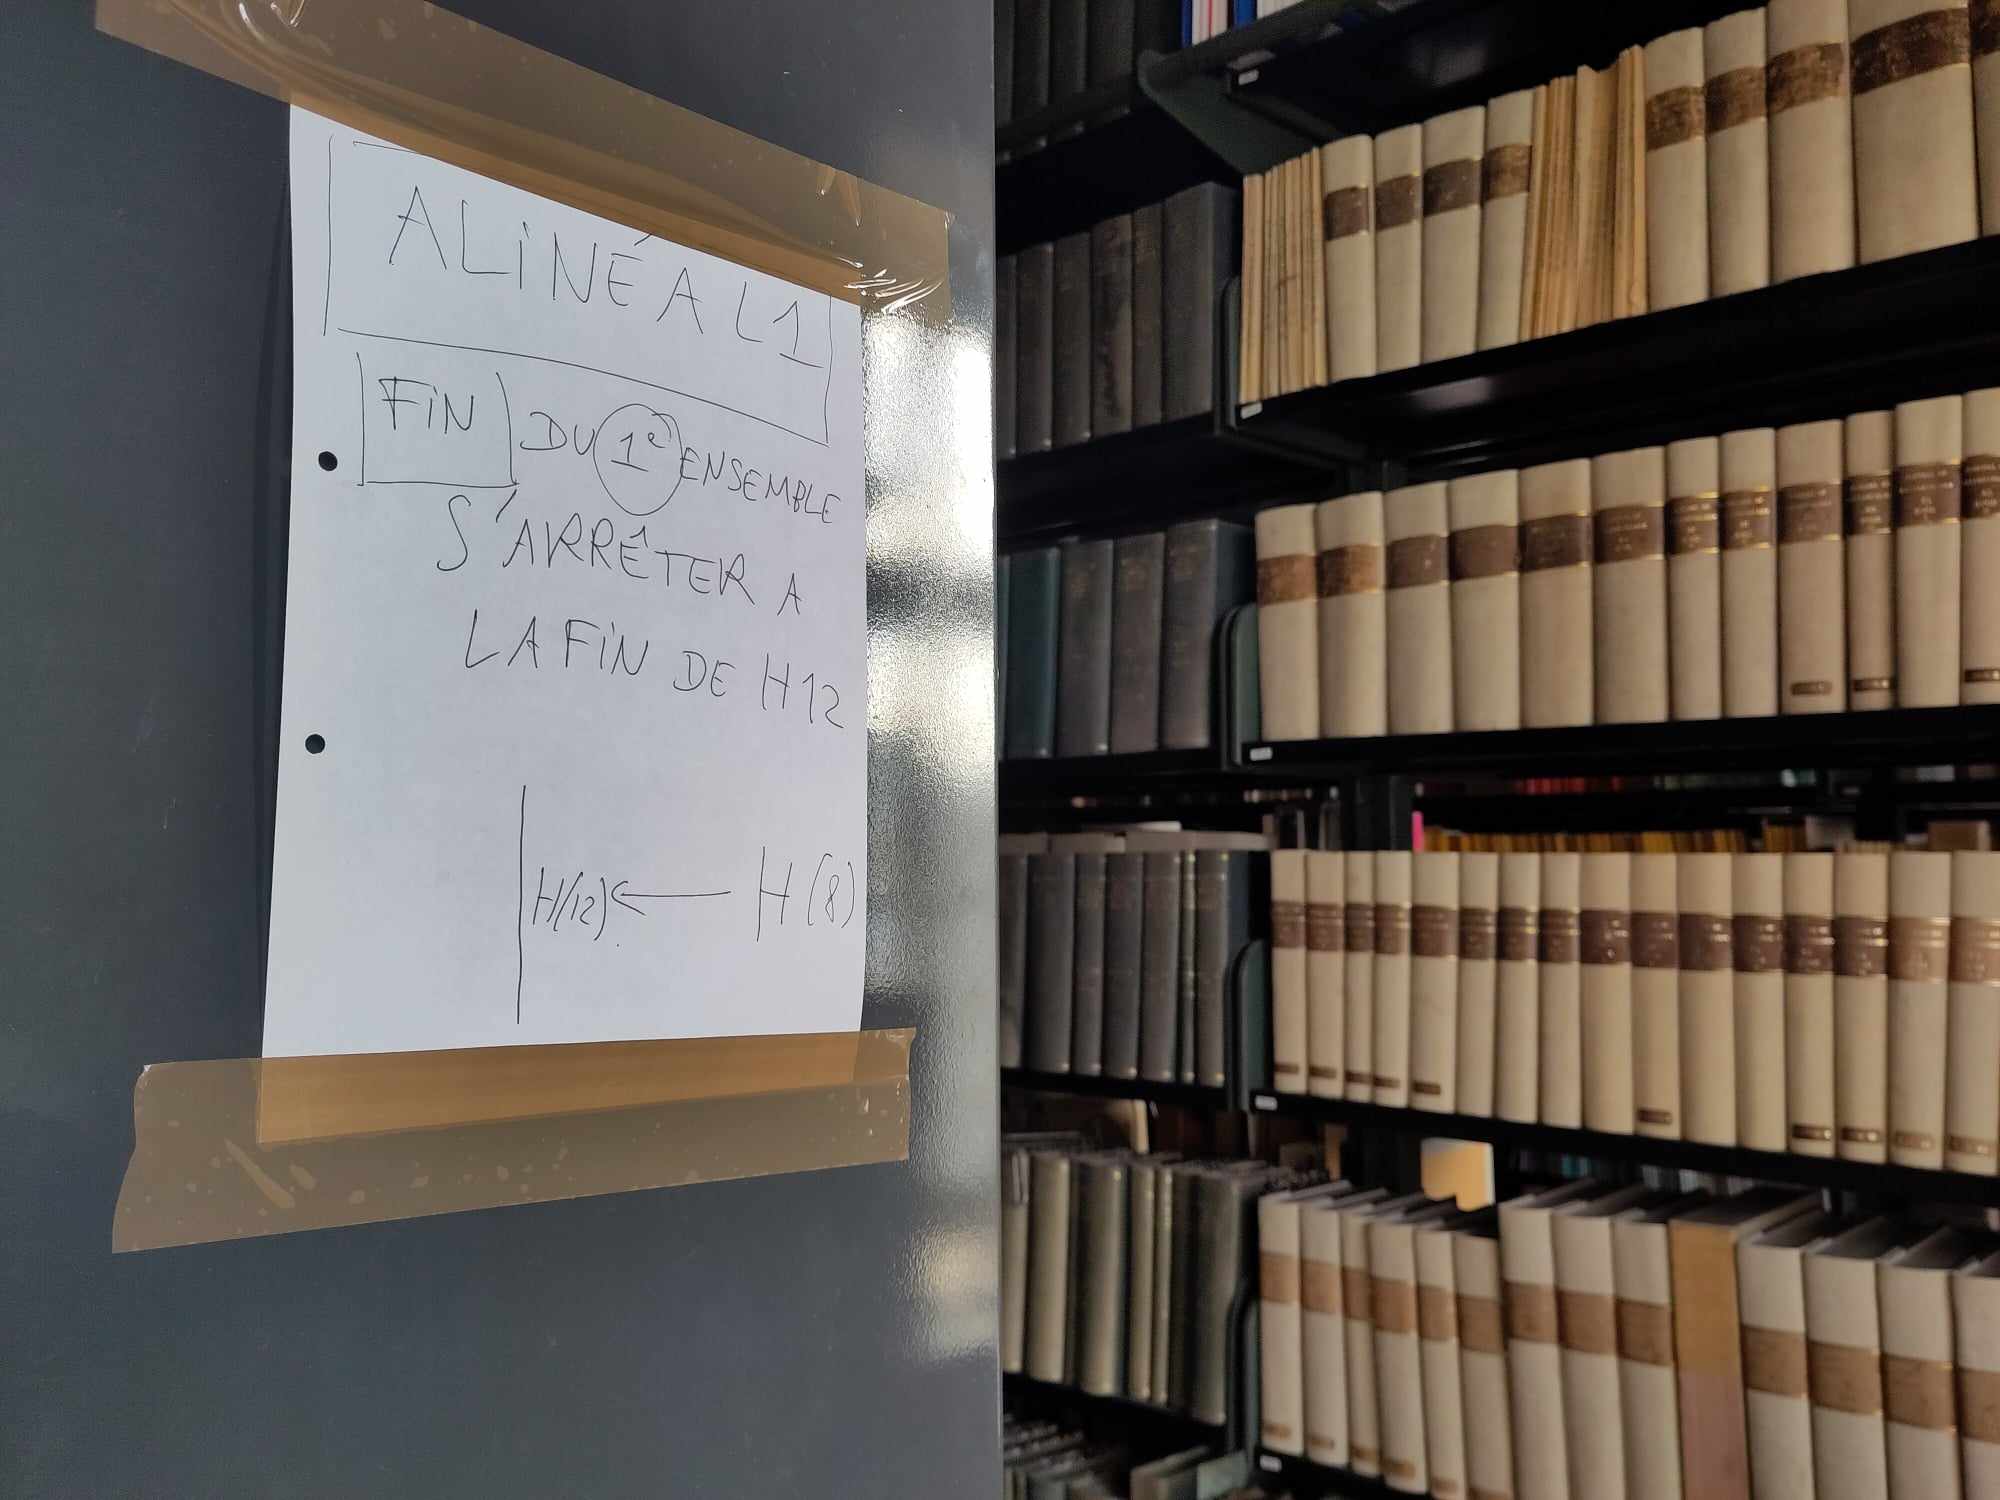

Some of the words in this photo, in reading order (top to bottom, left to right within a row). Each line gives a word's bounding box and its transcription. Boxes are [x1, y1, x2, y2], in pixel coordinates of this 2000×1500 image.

[519, 411, 595, 456] DU
[679, 446, 841, 524] ENSEMBLE
[776, 572, 803, 617] A
[465, 608, 540, 669] LA
[672, 650, 736, 697] DE
[761, 652, 844, 729] H12
